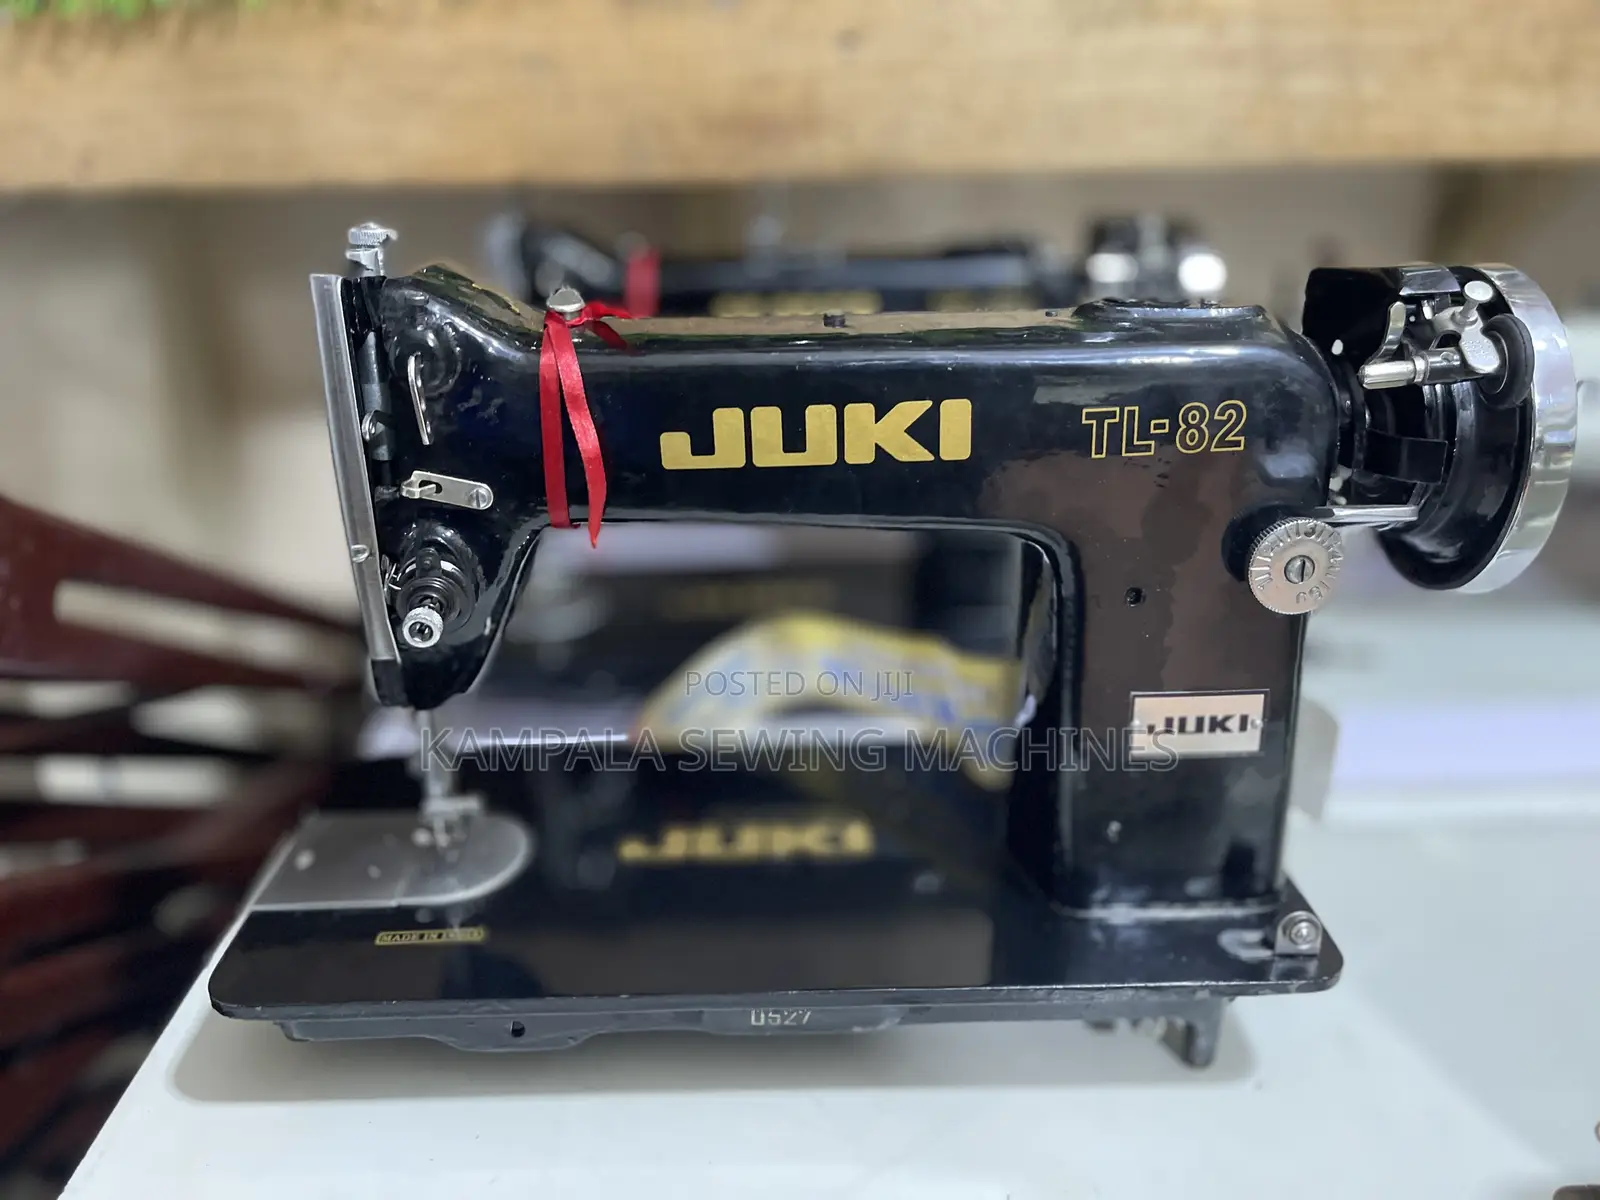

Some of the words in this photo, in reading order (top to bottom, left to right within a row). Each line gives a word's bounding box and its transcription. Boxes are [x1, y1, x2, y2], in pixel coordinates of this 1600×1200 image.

[660, 398, 972, 470] JUKI
[1082, 400, 1247, 459] TL-82
[1147, 714, 1250, 735] JUKI
